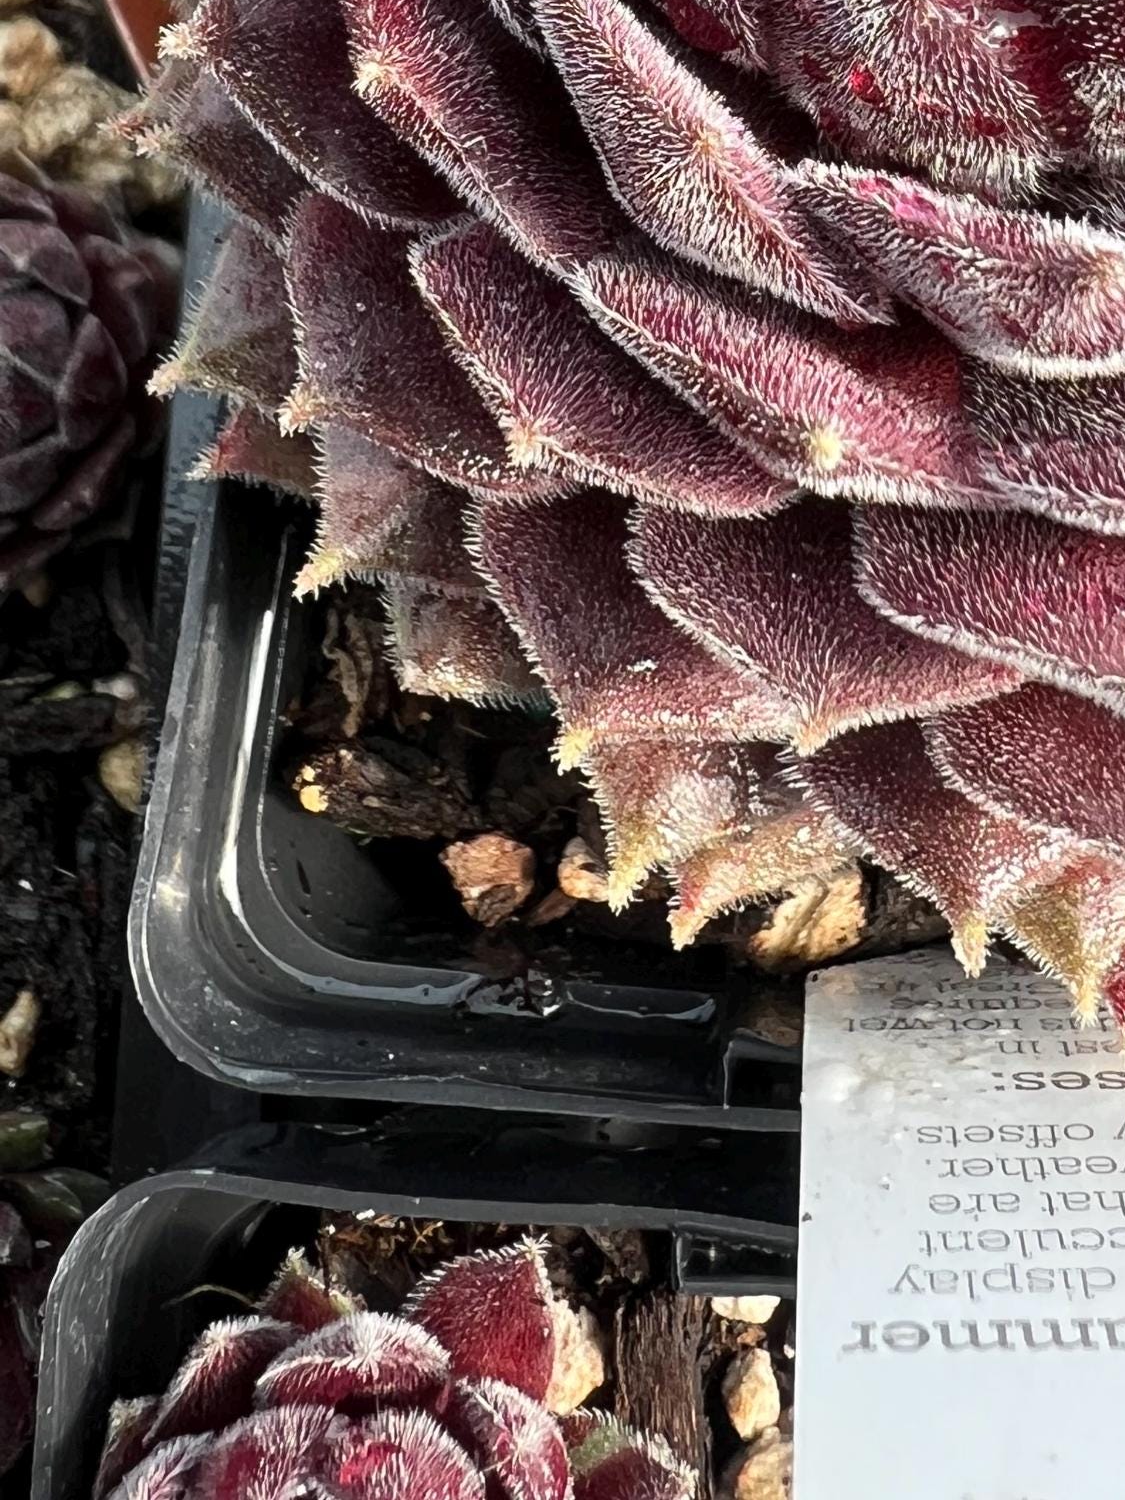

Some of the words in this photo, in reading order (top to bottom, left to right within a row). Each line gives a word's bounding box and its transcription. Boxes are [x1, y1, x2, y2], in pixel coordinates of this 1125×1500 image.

[944, 1017, 1021, 1033] not
[995, 1040, 1041, 1060] in
[904, 1122, 1095, 1150] offsets.
[928, 1192, 1020, 1216] are
[887, 1263, 1116, 1303] display
